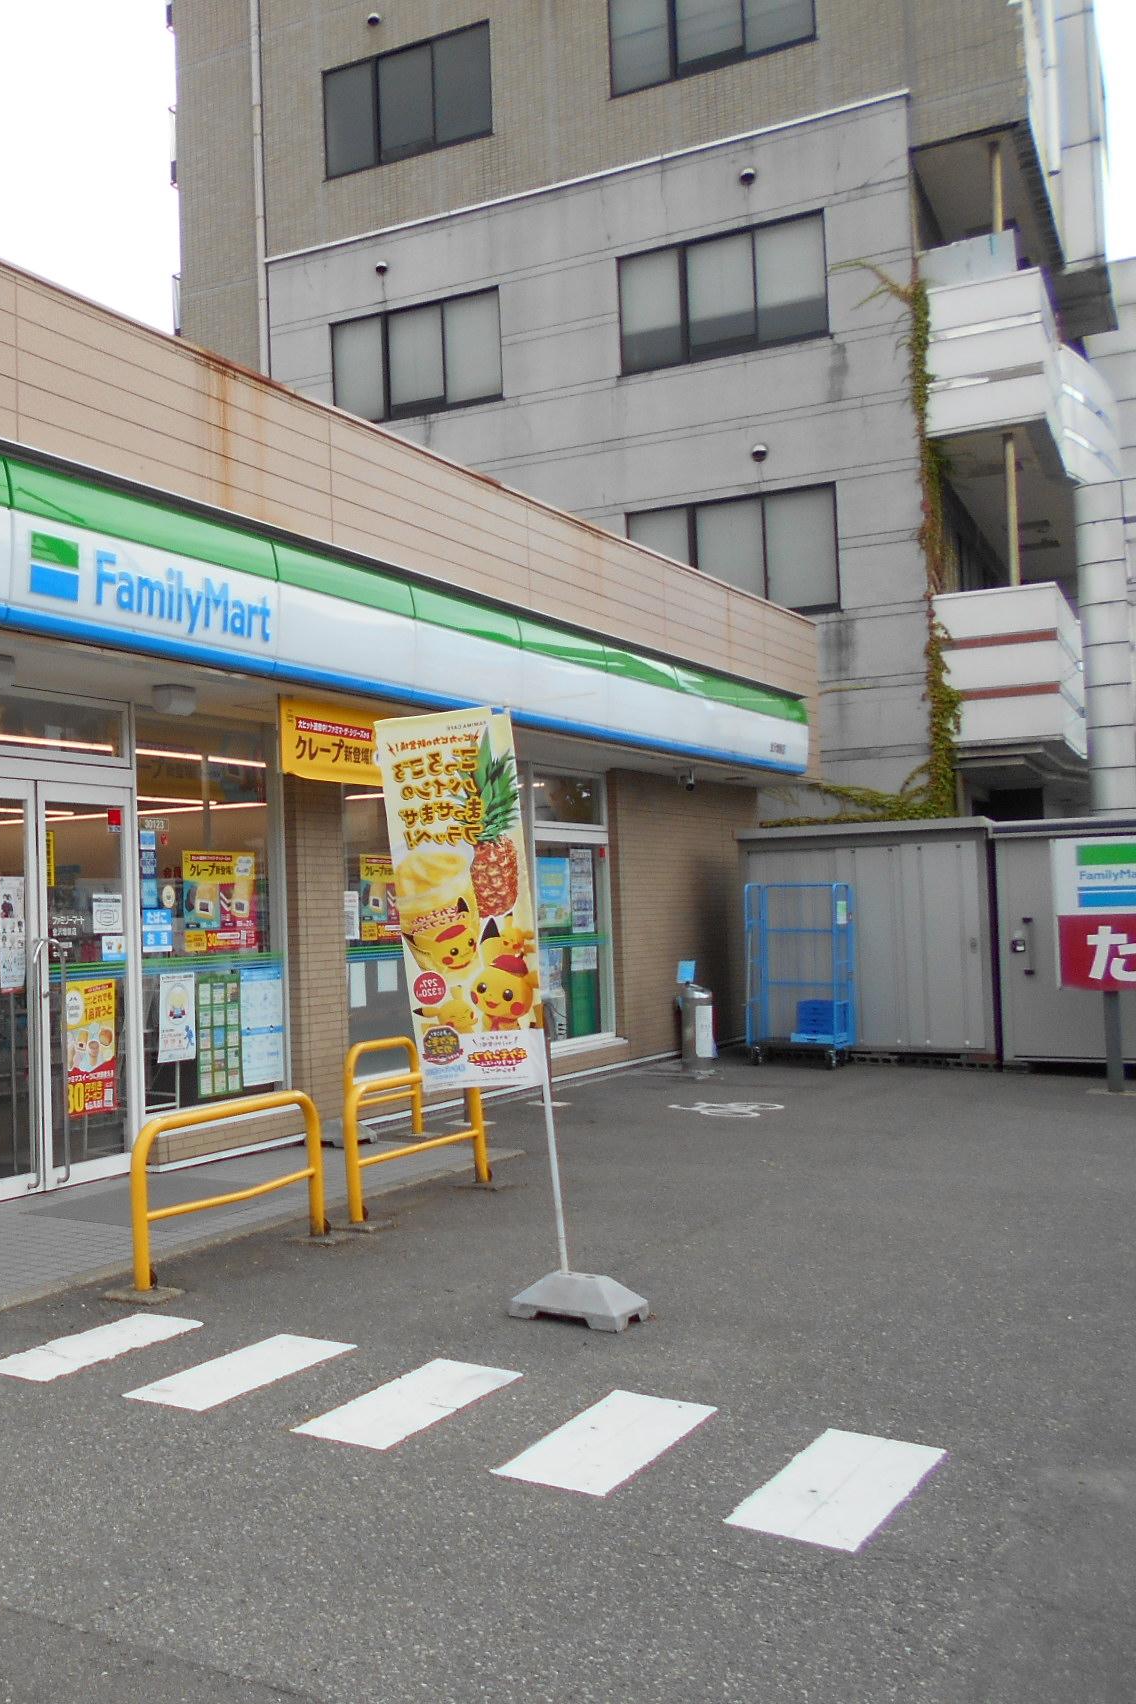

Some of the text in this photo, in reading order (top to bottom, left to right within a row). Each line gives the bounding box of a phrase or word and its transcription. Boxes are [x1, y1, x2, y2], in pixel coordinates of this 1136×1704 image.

[95, 549, 271, 642] FamilyMart
[295, 735, 373, 765] クレープ新登場!
[144, 820, 165, 829] 30123
[52, 915, 85, 926] ファミリーマート
